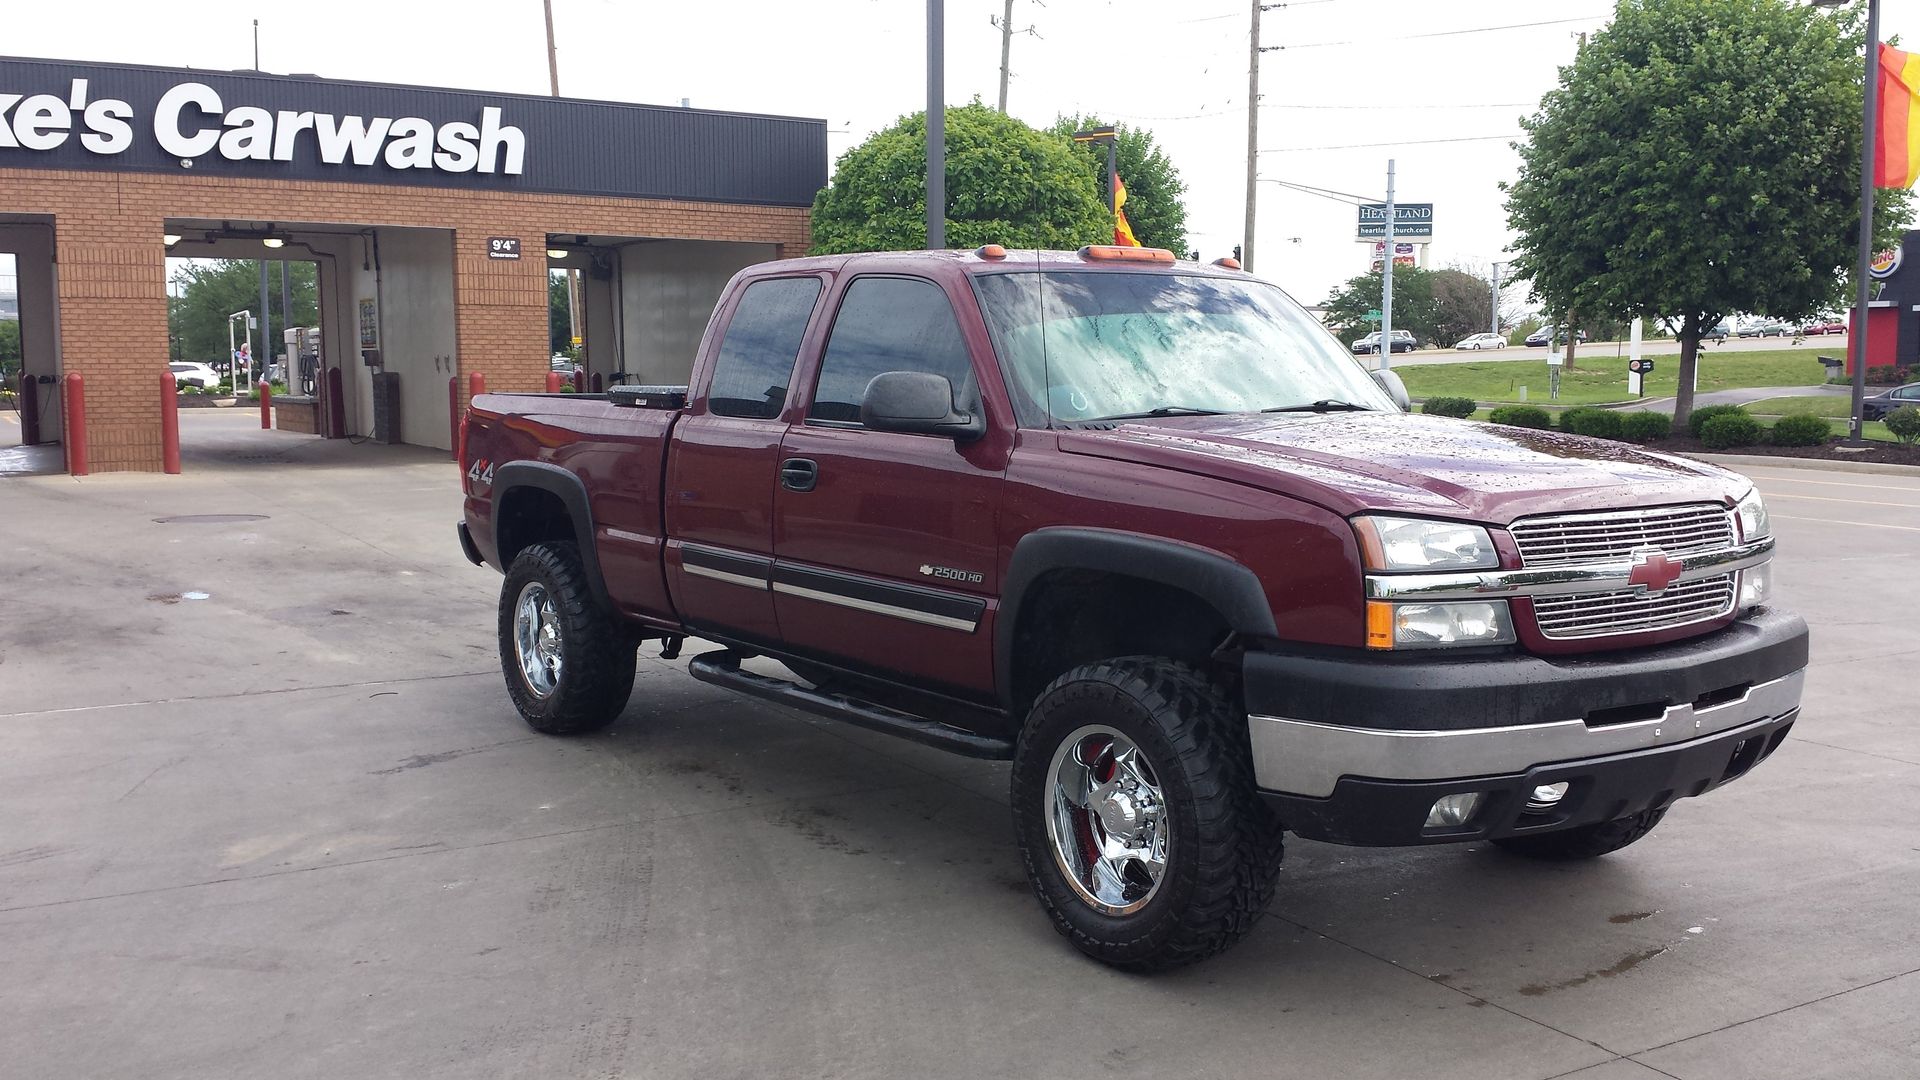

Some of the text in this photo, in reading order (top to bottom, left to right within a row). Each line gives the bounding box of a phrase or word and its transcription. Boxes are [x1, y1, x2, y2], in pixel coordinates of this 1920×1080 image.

[153, 82, 526, 175] Carwash
[1360, 206, 1432, 219] HEATLAND
[492, 239, 516, 251] 9'4"
[934, 567, 983, 583] 2500 HD
